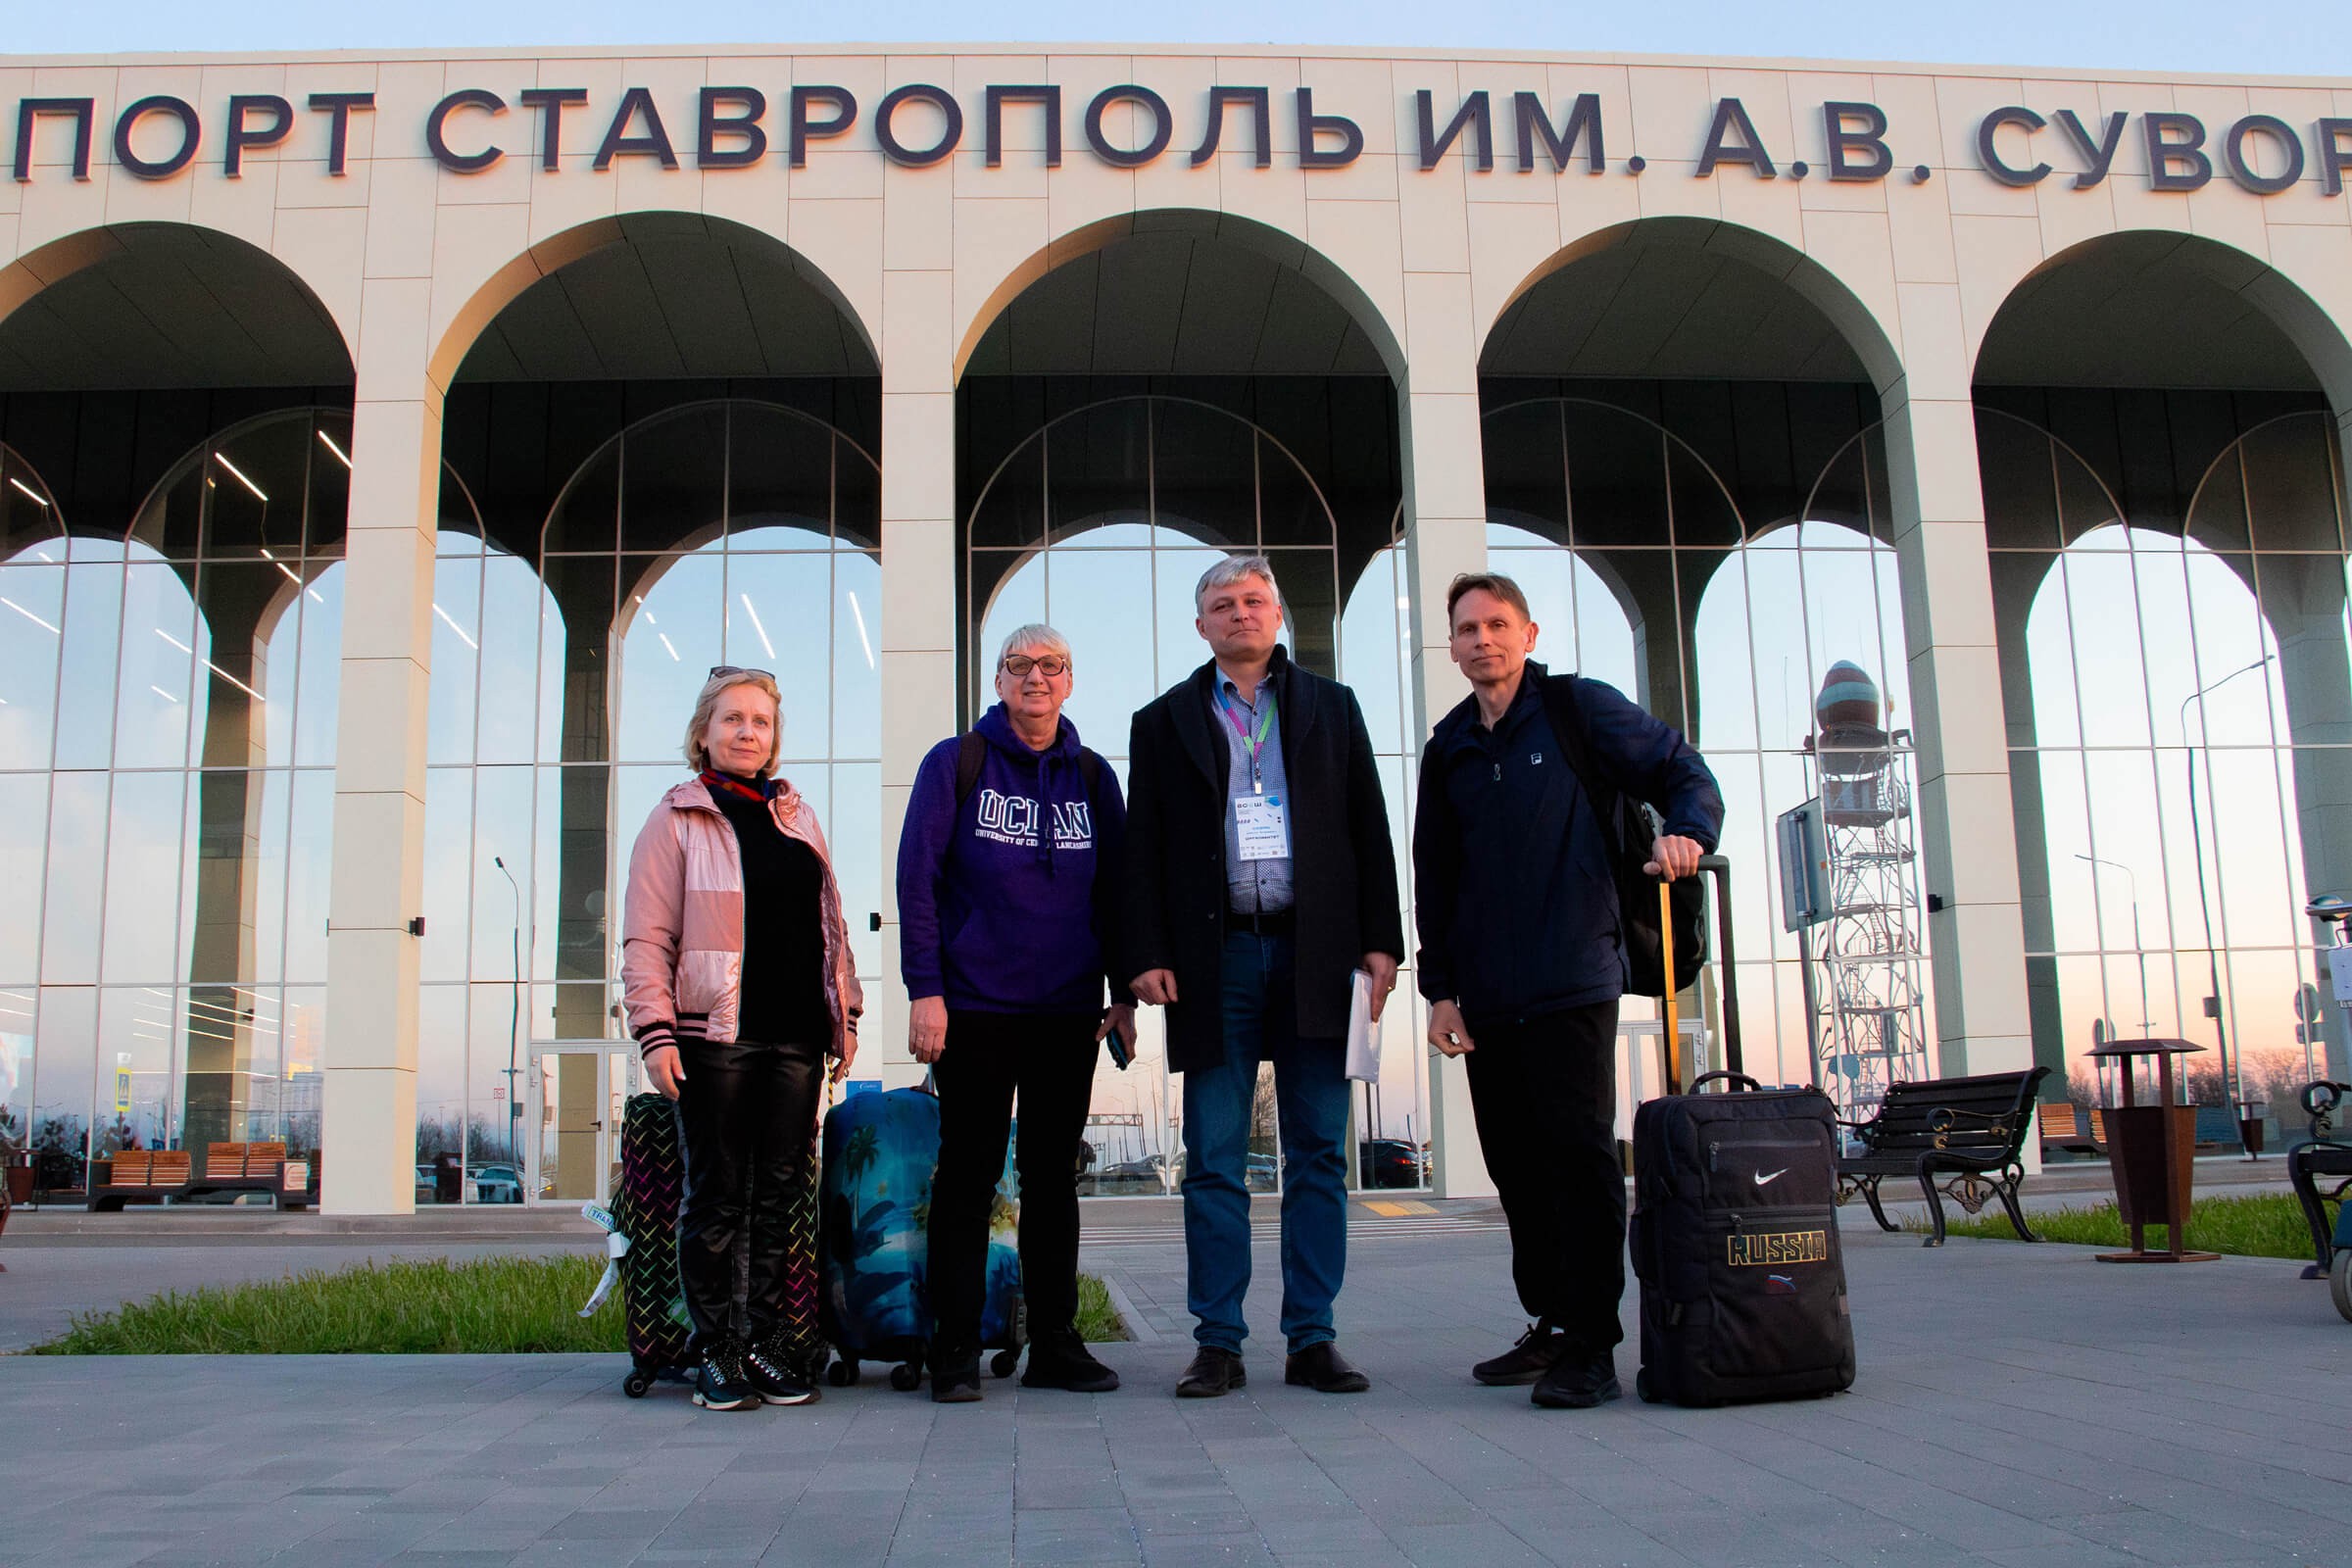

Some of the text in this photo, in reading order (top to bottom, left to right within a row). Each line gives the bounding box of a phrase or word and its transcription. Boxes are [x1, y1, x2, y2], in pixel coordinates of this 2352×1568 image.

[12, 92, 376, 184] ПОРТ
[425, 83, 1365, 175] СТАВРОПОЛЬ
[1416, 89, 1646, 177] ИМ.
[975, 828, 1015, 844] UNIVERSITY
[1727, 1230, 1827, 1266] RUSSIA
